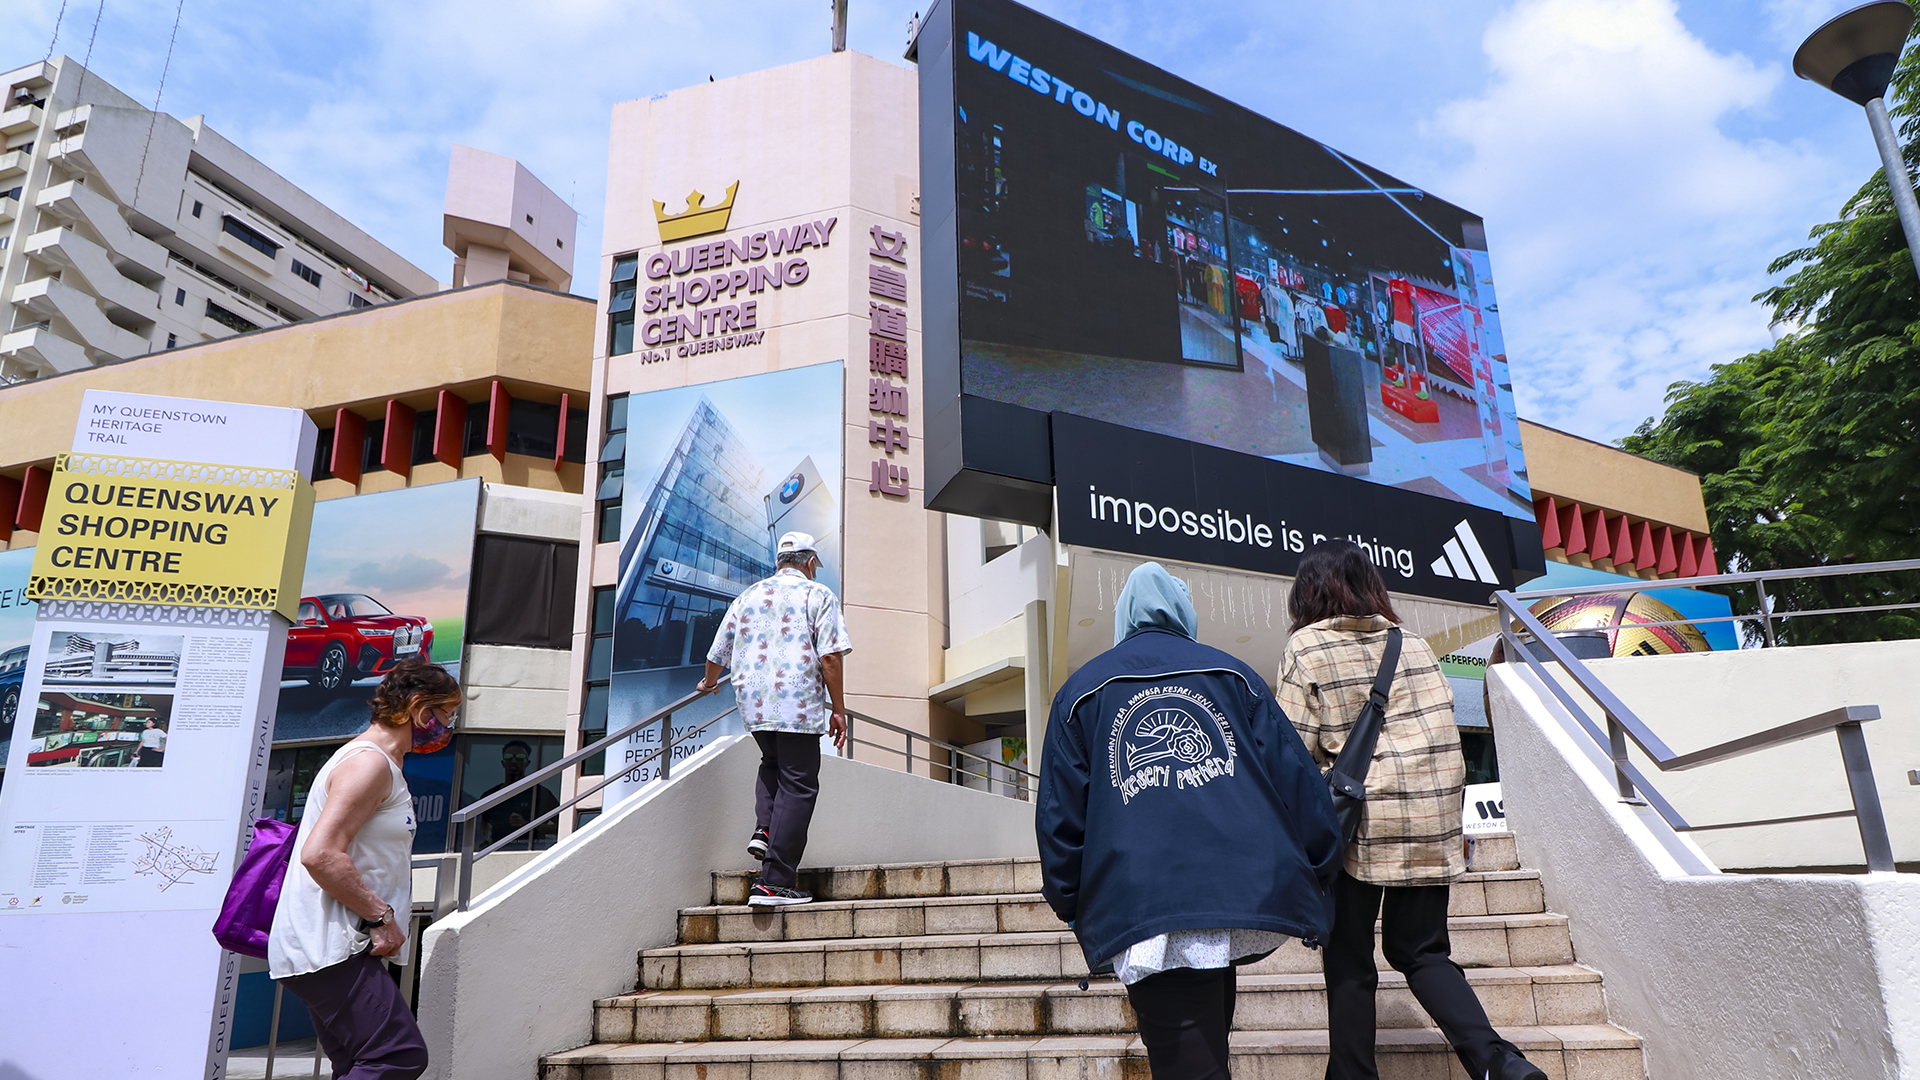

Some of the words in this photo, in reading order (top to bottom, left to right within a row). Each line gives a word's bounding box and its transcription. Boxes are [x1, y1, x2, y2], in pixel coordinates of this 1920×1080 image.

[968, 31, 1120, 131] WESTON
[1126, 120, 1194, 165] CORP
[1199, 156, 1218, 177] EX
[645, 217, 838, 279] QUEENSWAY
[642, 257, 810, 314] SHOPPING
[641, 301, 758, 347] CENTRE
[677, 331, 765, 358] QUEENSWAY
[90, 418, 163, 434] HERITAGE
[93, 404, 117, 416] MY
[120, 406, 228, 426] QUEENSTOWN
[87, 432, 128, 445] TRAIL
[64, 482, 279, 518] QUEENSWAY
[57, 513, 229, 546] SHOPPING
[1089, 485, 1273, 548] impossible
[1281, 520, 1305, 553] is
[51, 546, 183, 574] CENTRE
[255, 715, 270, 771] TRAIL
[623, 767, 649, 783] 303
[1465, 822, 1498, 830] WESTON
